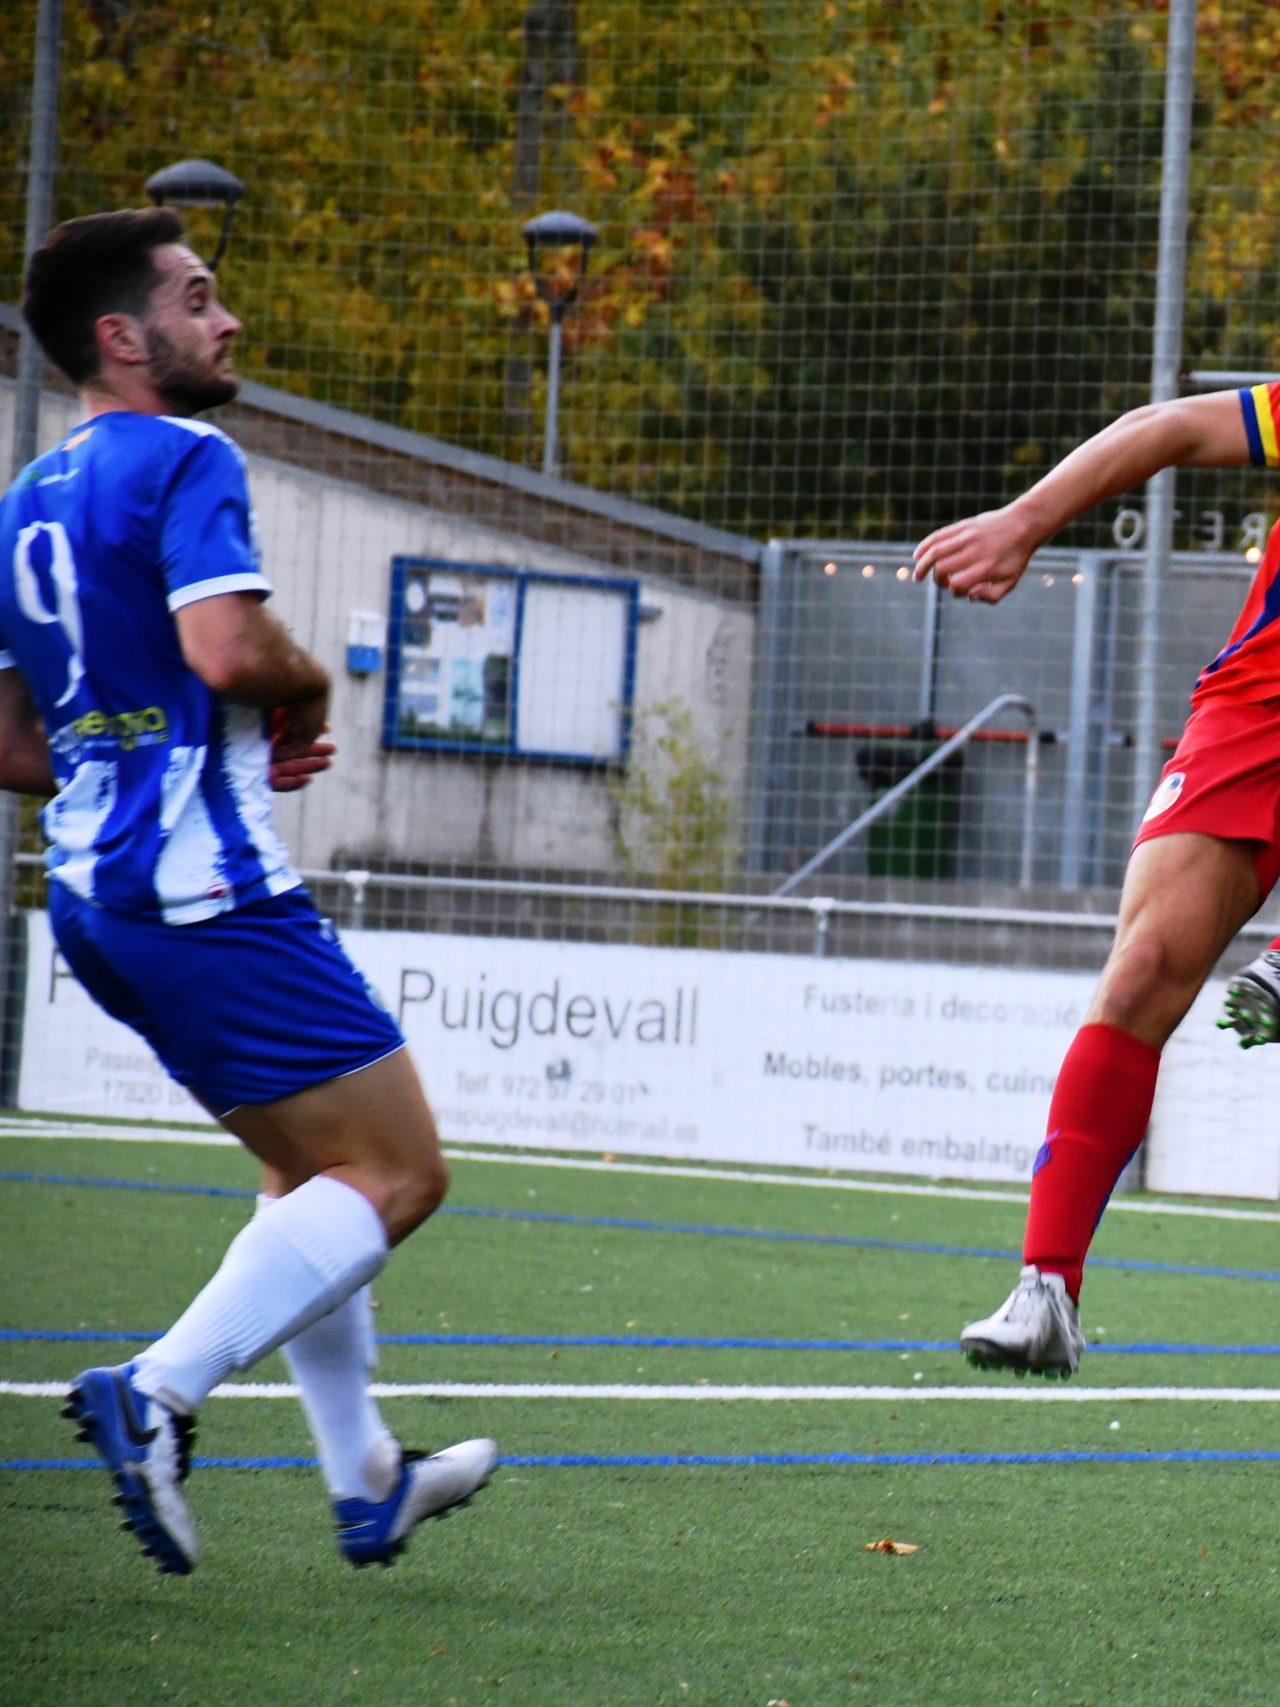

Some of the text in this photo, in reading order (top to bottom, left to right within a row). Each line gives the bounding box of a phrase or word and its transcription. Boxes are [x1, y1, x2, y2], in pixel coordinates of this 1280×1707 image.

[13, 520, 86, 708] 9
[398, 968, 699, 1050] Puigdevall
[803, 986, 915, 1017] Fusteria
[940, 995, 1079, 1027] decoració
[502, 1074, 541, 1100] 972
[579, 1080, 607, 1104] 29
[803, 1123, 1034, 1172] També embalatg
